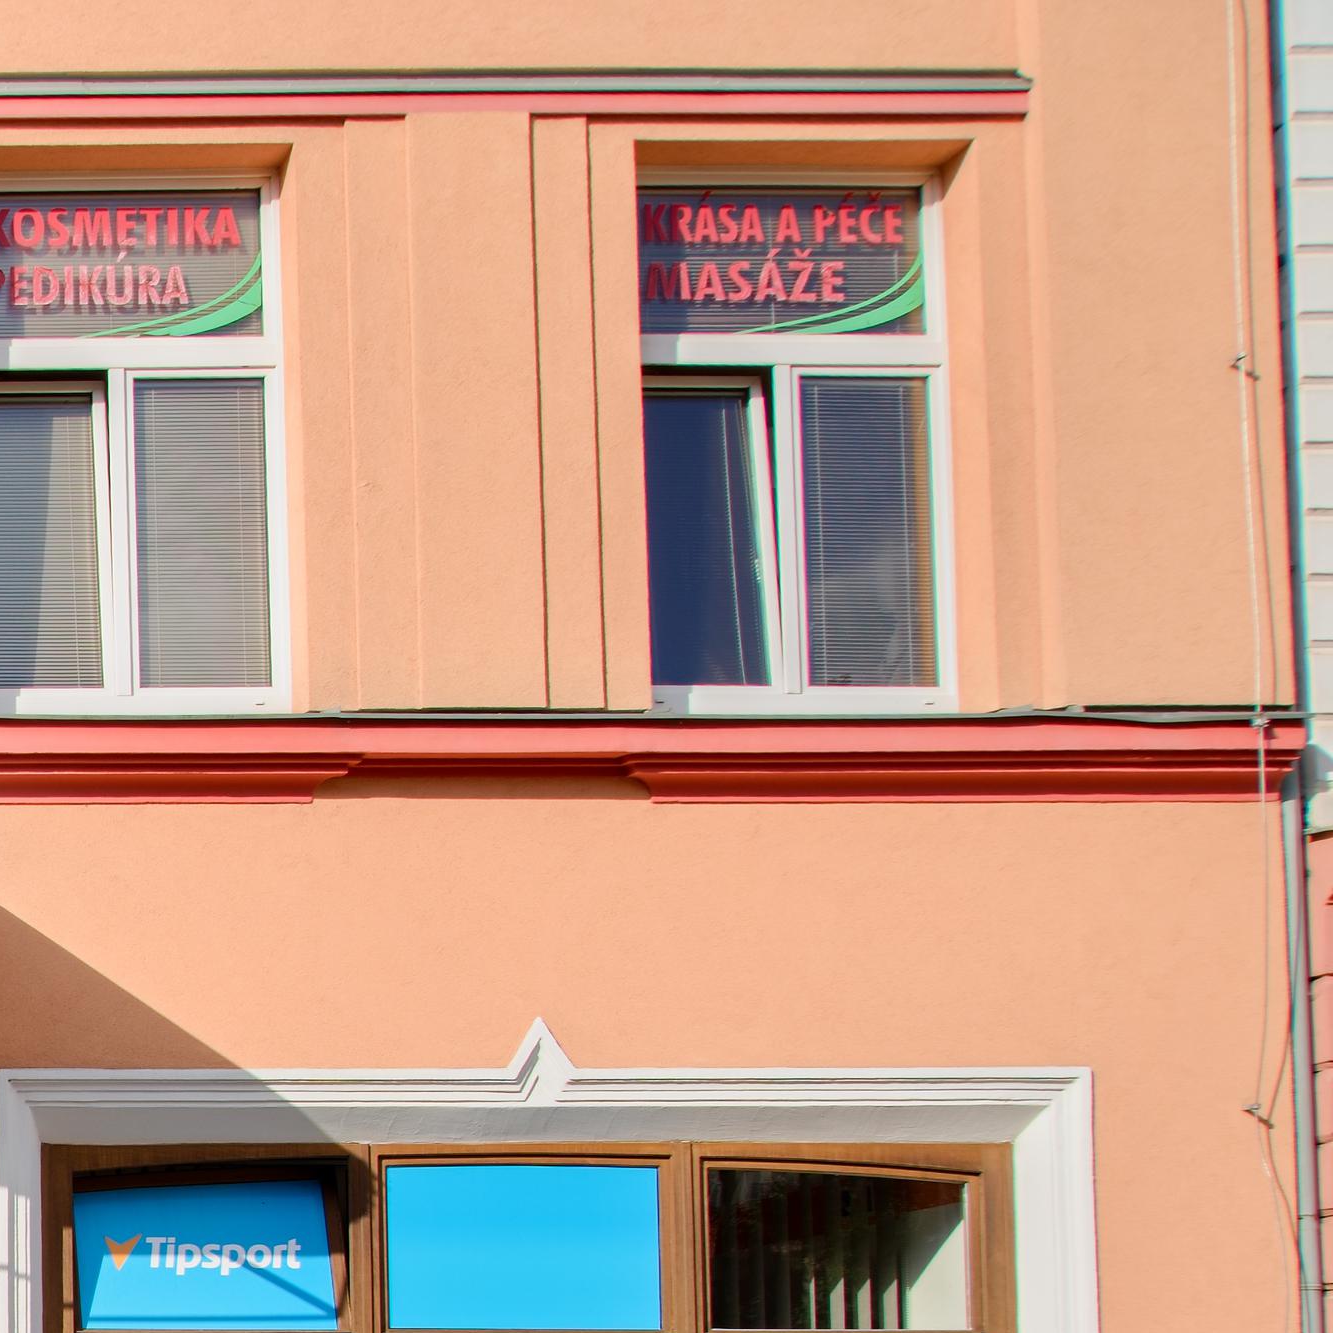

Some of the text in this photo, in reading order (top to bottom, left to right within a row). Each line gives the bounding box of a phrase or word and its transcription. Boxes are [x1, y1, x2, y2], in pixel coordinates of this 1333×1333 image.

[643, 190, 904, 244] KRÁSA A PÉČE
[647, 248, 847, 302] MASÁŽE
[145, 1236, 302, 1276] Tipsport
